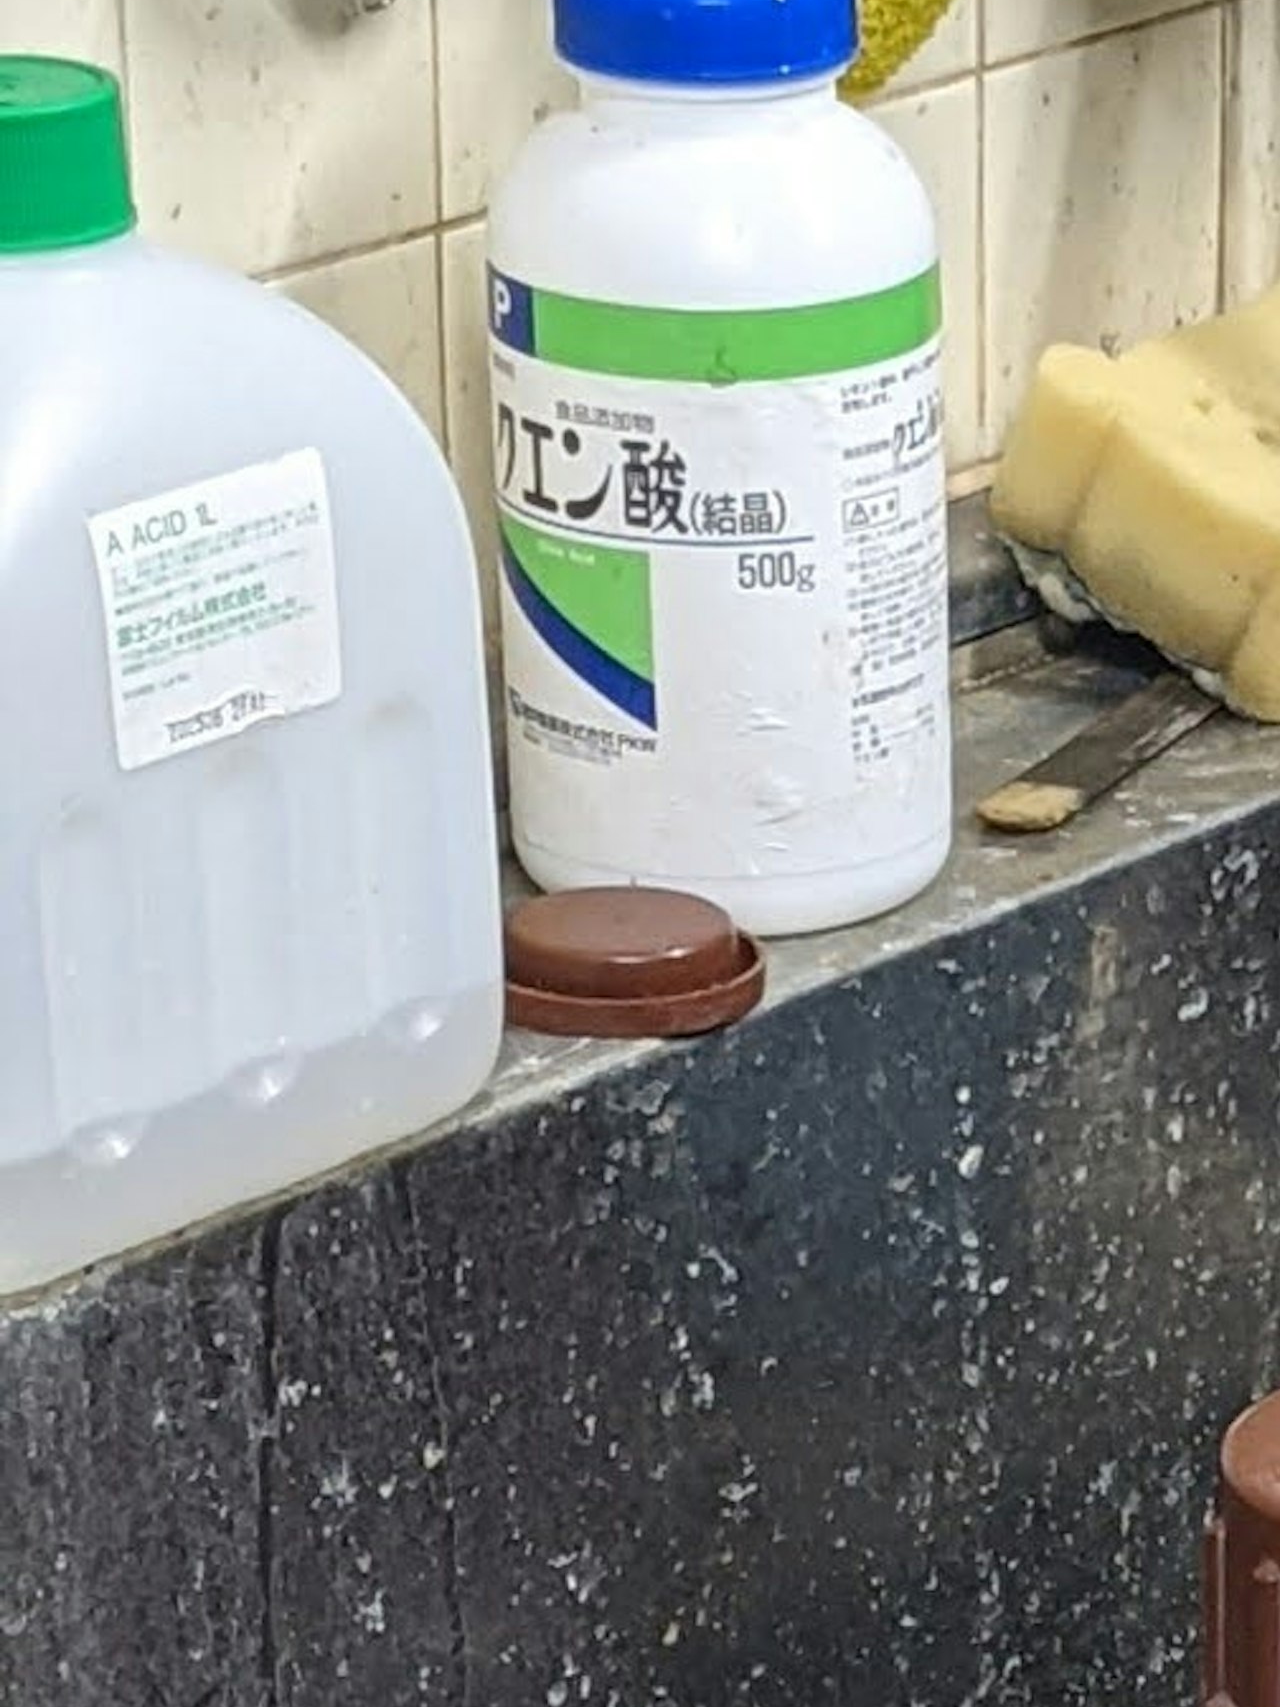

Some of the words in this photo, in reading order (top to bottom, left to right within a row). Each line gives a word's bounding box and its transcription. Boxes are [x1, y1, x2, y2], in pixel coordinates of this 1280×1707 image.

[106, 529, 125, 559] A
[131, 506, 187, 552] ACID
[737, 550, 816, 593] 500g
